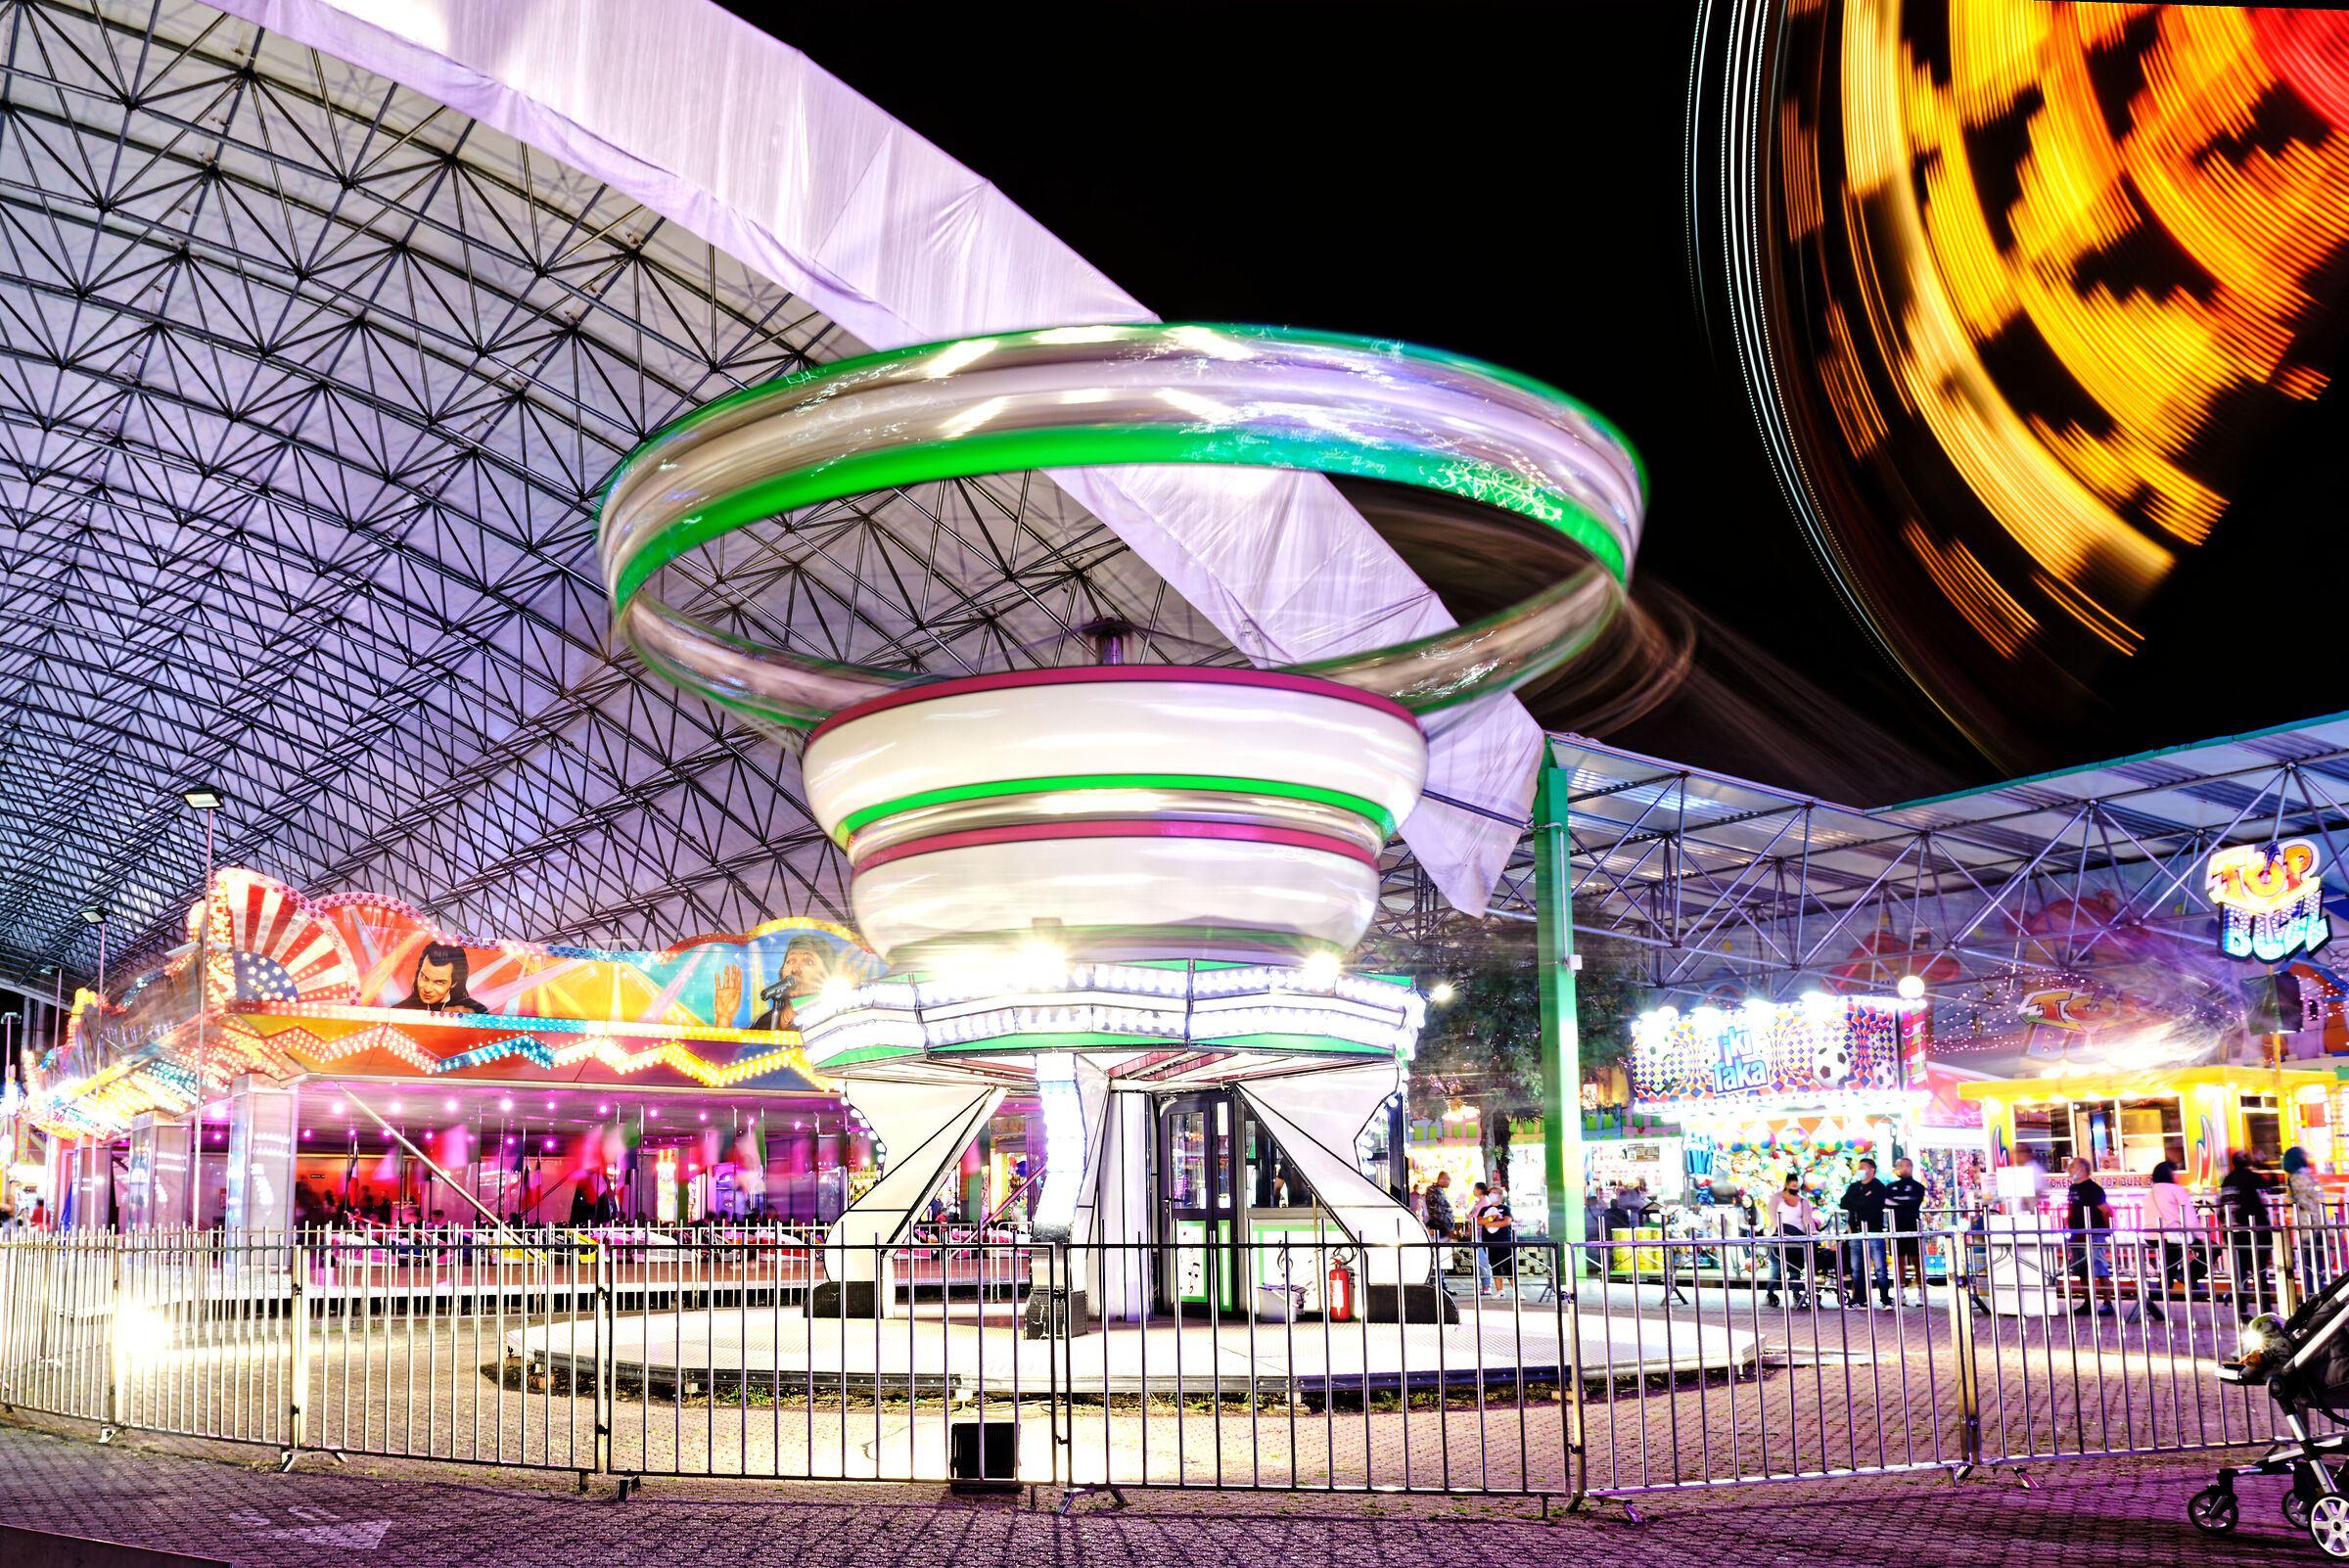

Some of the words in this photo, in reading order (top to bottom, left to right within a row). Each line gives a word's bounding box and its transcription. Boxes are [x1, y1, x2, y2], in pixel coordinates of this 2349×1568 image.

[2209, 843, 2318, 902] TOP
[2222, 891, 2329, 960] BUZZ
[1712, 1058, 1768, 1093] Taka
[2100, 1176, 2118, 1187] TOP
